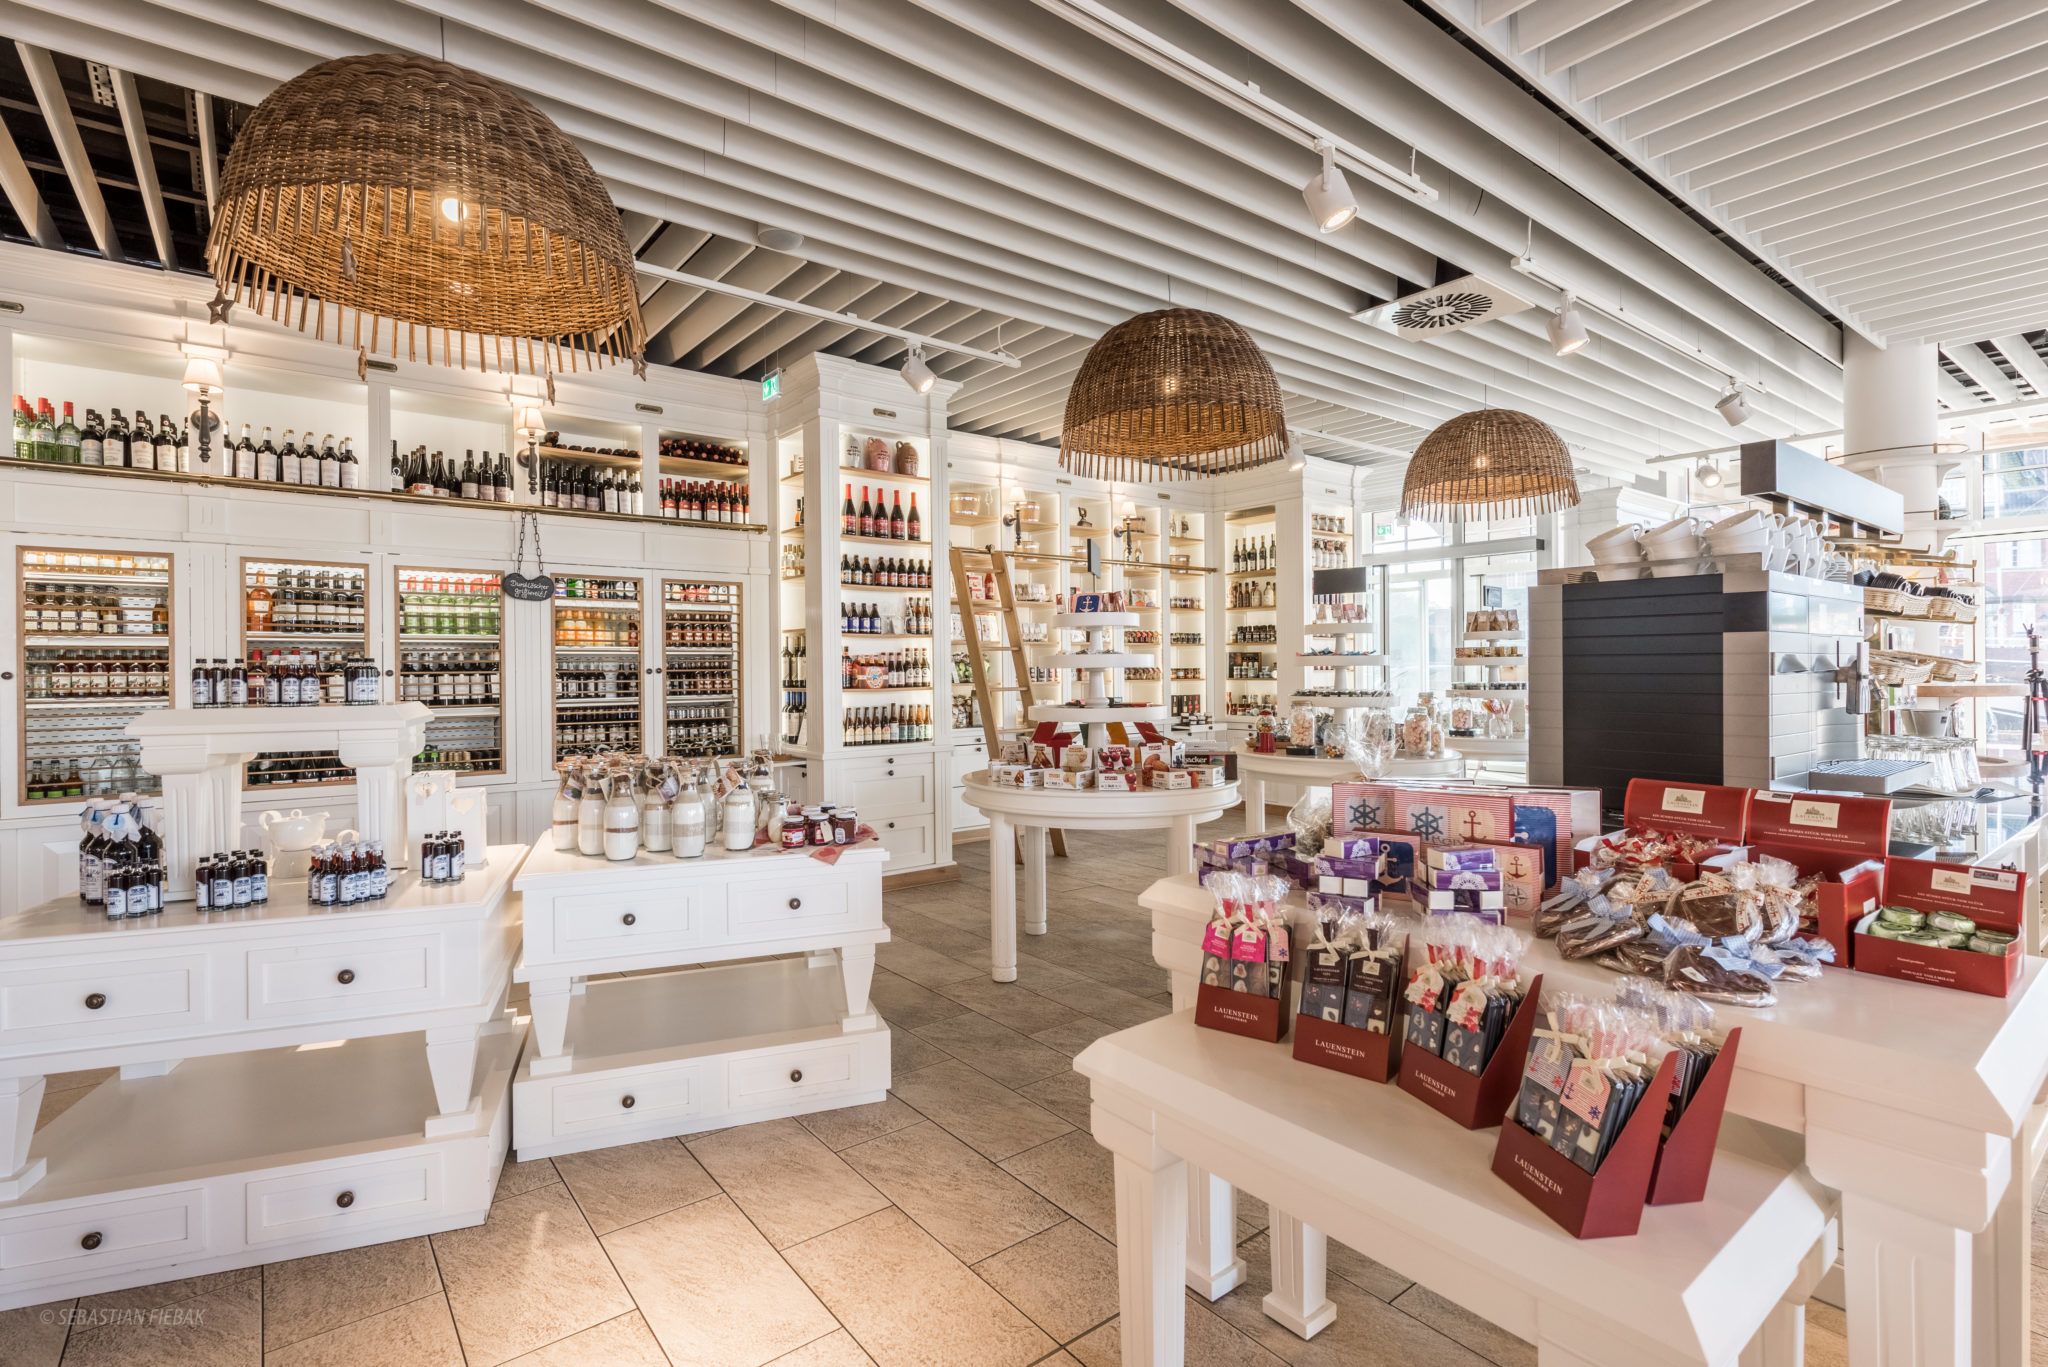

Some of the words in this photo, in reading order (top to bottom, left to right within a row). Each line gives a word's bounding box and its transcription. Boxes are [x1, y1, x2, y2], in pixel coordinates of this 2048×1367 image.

[1214, 1005, 1259, 1021] LAUENSTEIN
[1315, 1039, 1366, 1058] LAUENSTEIN
[1415, 1069, 1456, 1097] LAUENSTEIN
[1514, 1154, 1563, 1195] LAUENSTEIN
